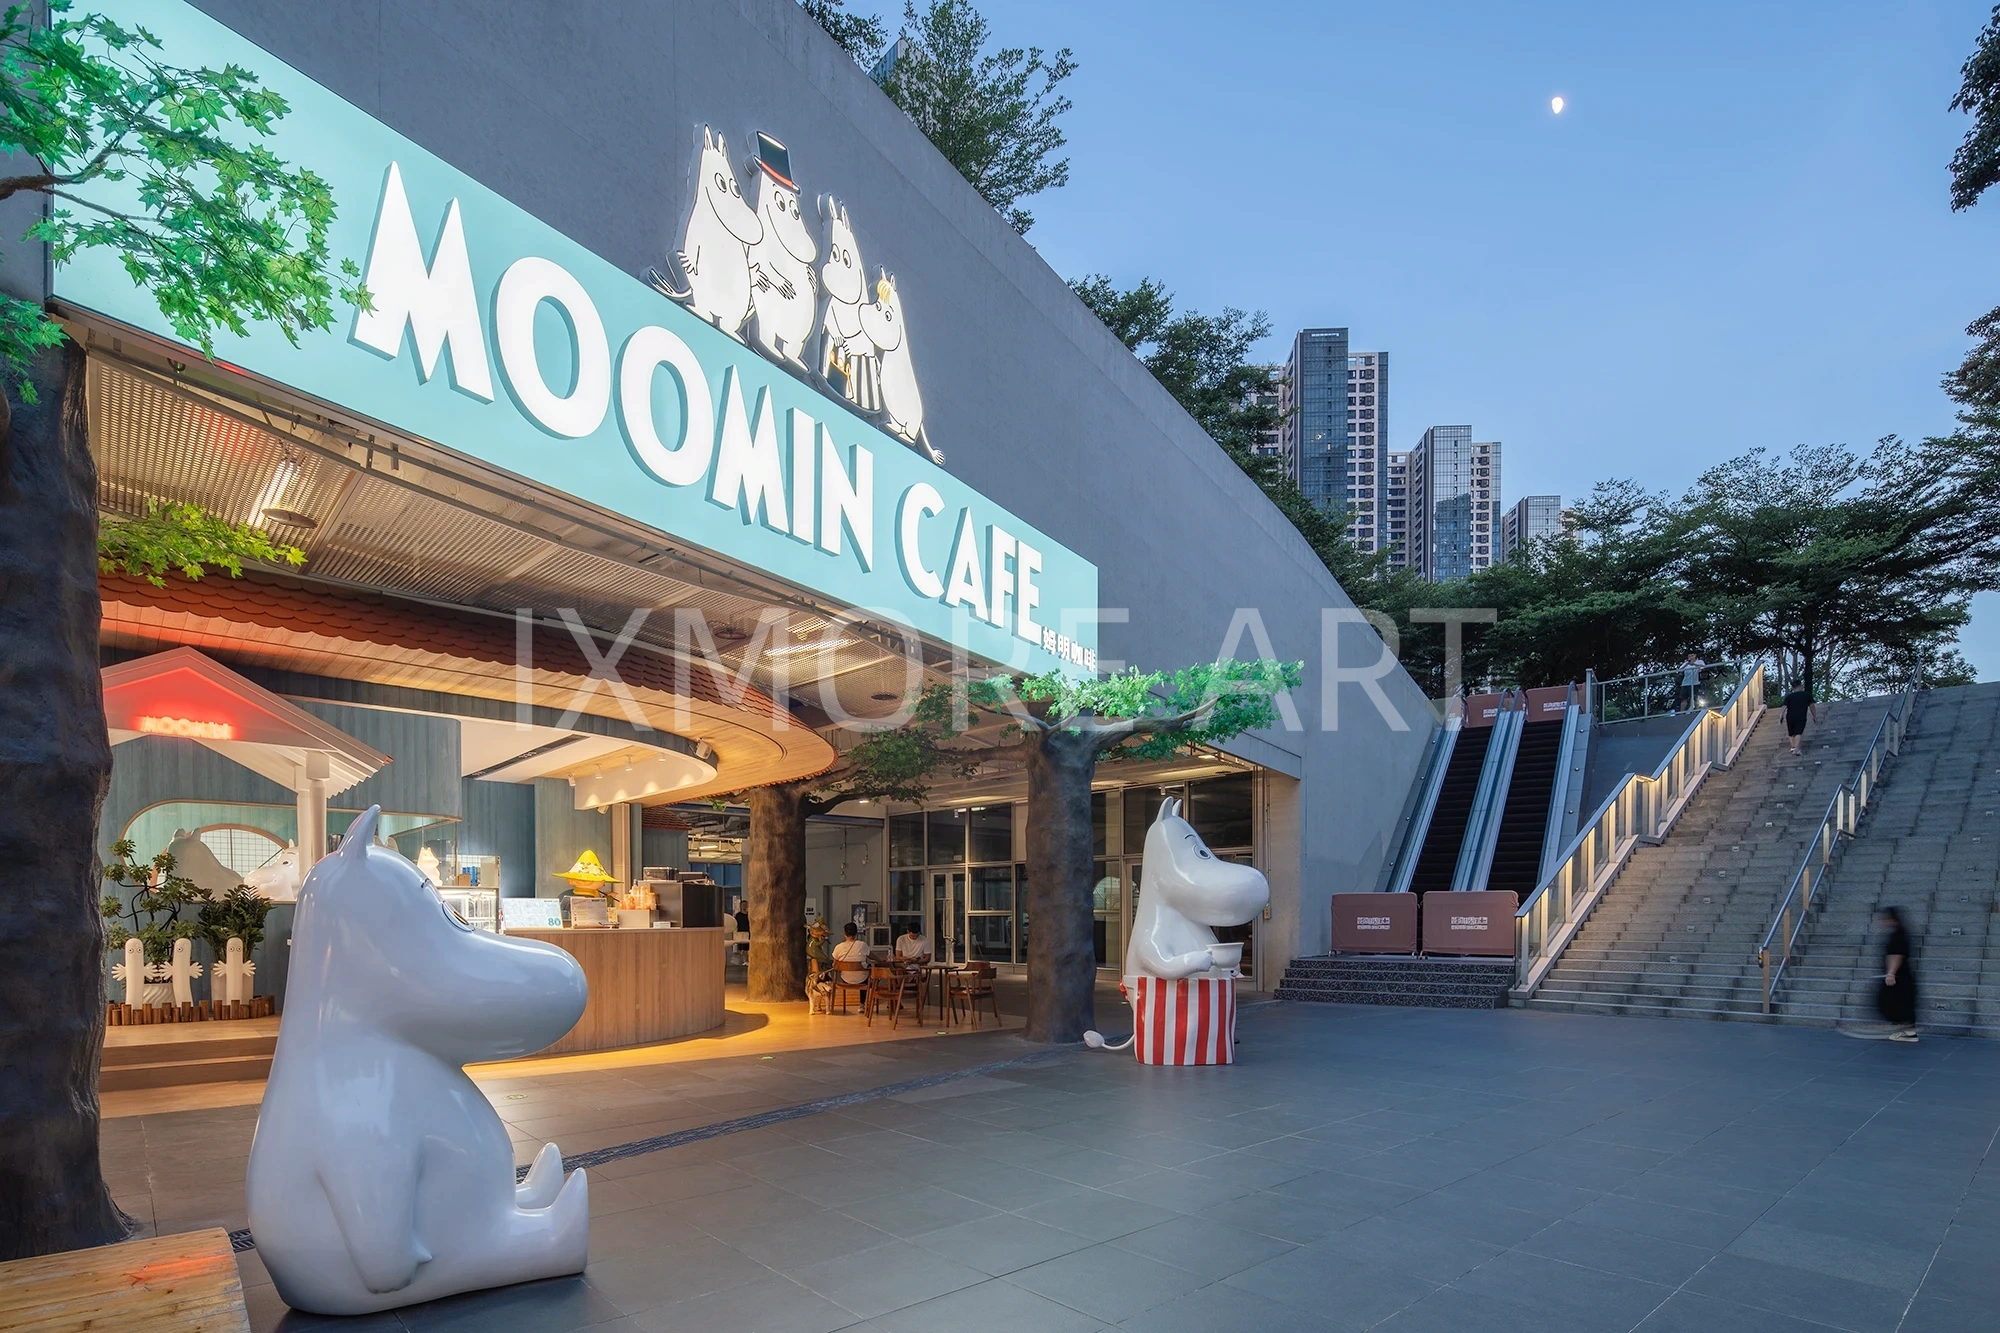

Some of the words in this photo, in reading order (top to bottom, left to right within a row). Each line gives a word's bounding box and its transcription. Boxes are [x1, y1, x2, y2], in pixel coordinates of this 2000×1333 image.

[347, 160, 874, 575] MOOMIN
[895, 482, 1043, 646] CAFE
[1041, 626, 1096, 672] 姆明咖啡
